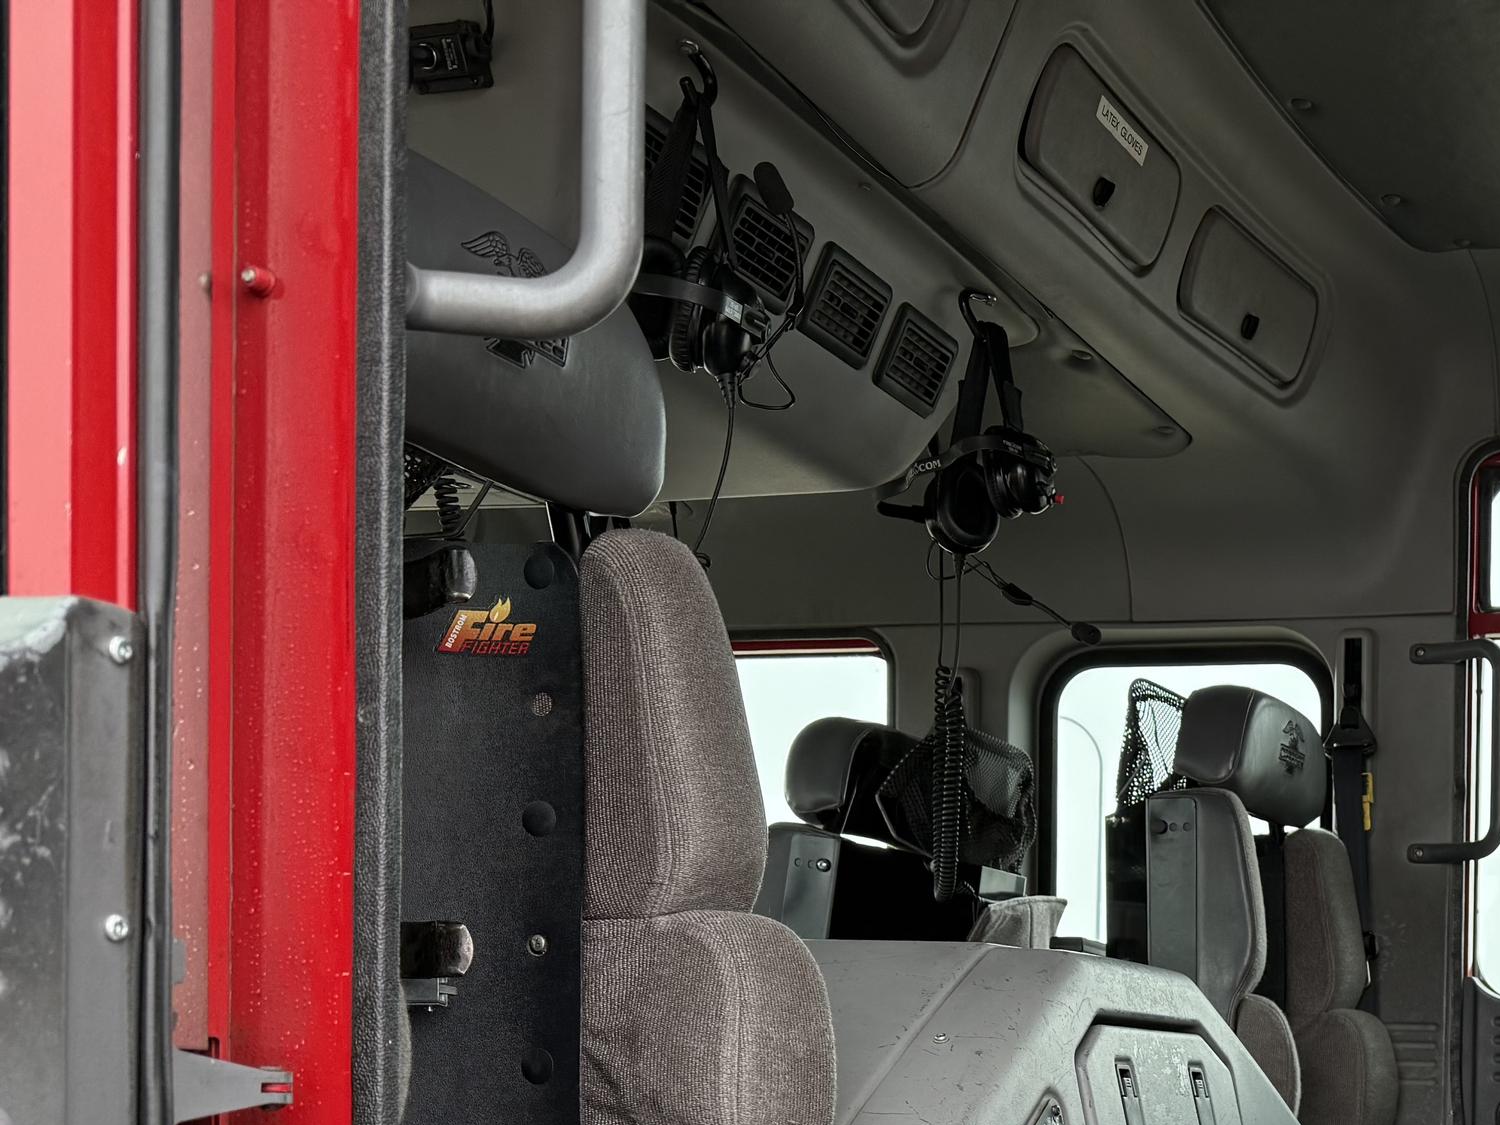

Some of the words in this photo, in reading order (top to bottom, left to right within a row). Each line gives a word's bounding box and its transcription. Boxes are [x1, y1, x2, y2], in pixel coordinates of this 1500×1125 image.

[1101, 104, 1120, 130] LATEX
[1120, 126, 1143, 155] GLOVES
[438, 598, 537, 652] Fire
[445, 613, 467, 648] BOSTROM
[461, 640, 530, 655] FIGHTER
